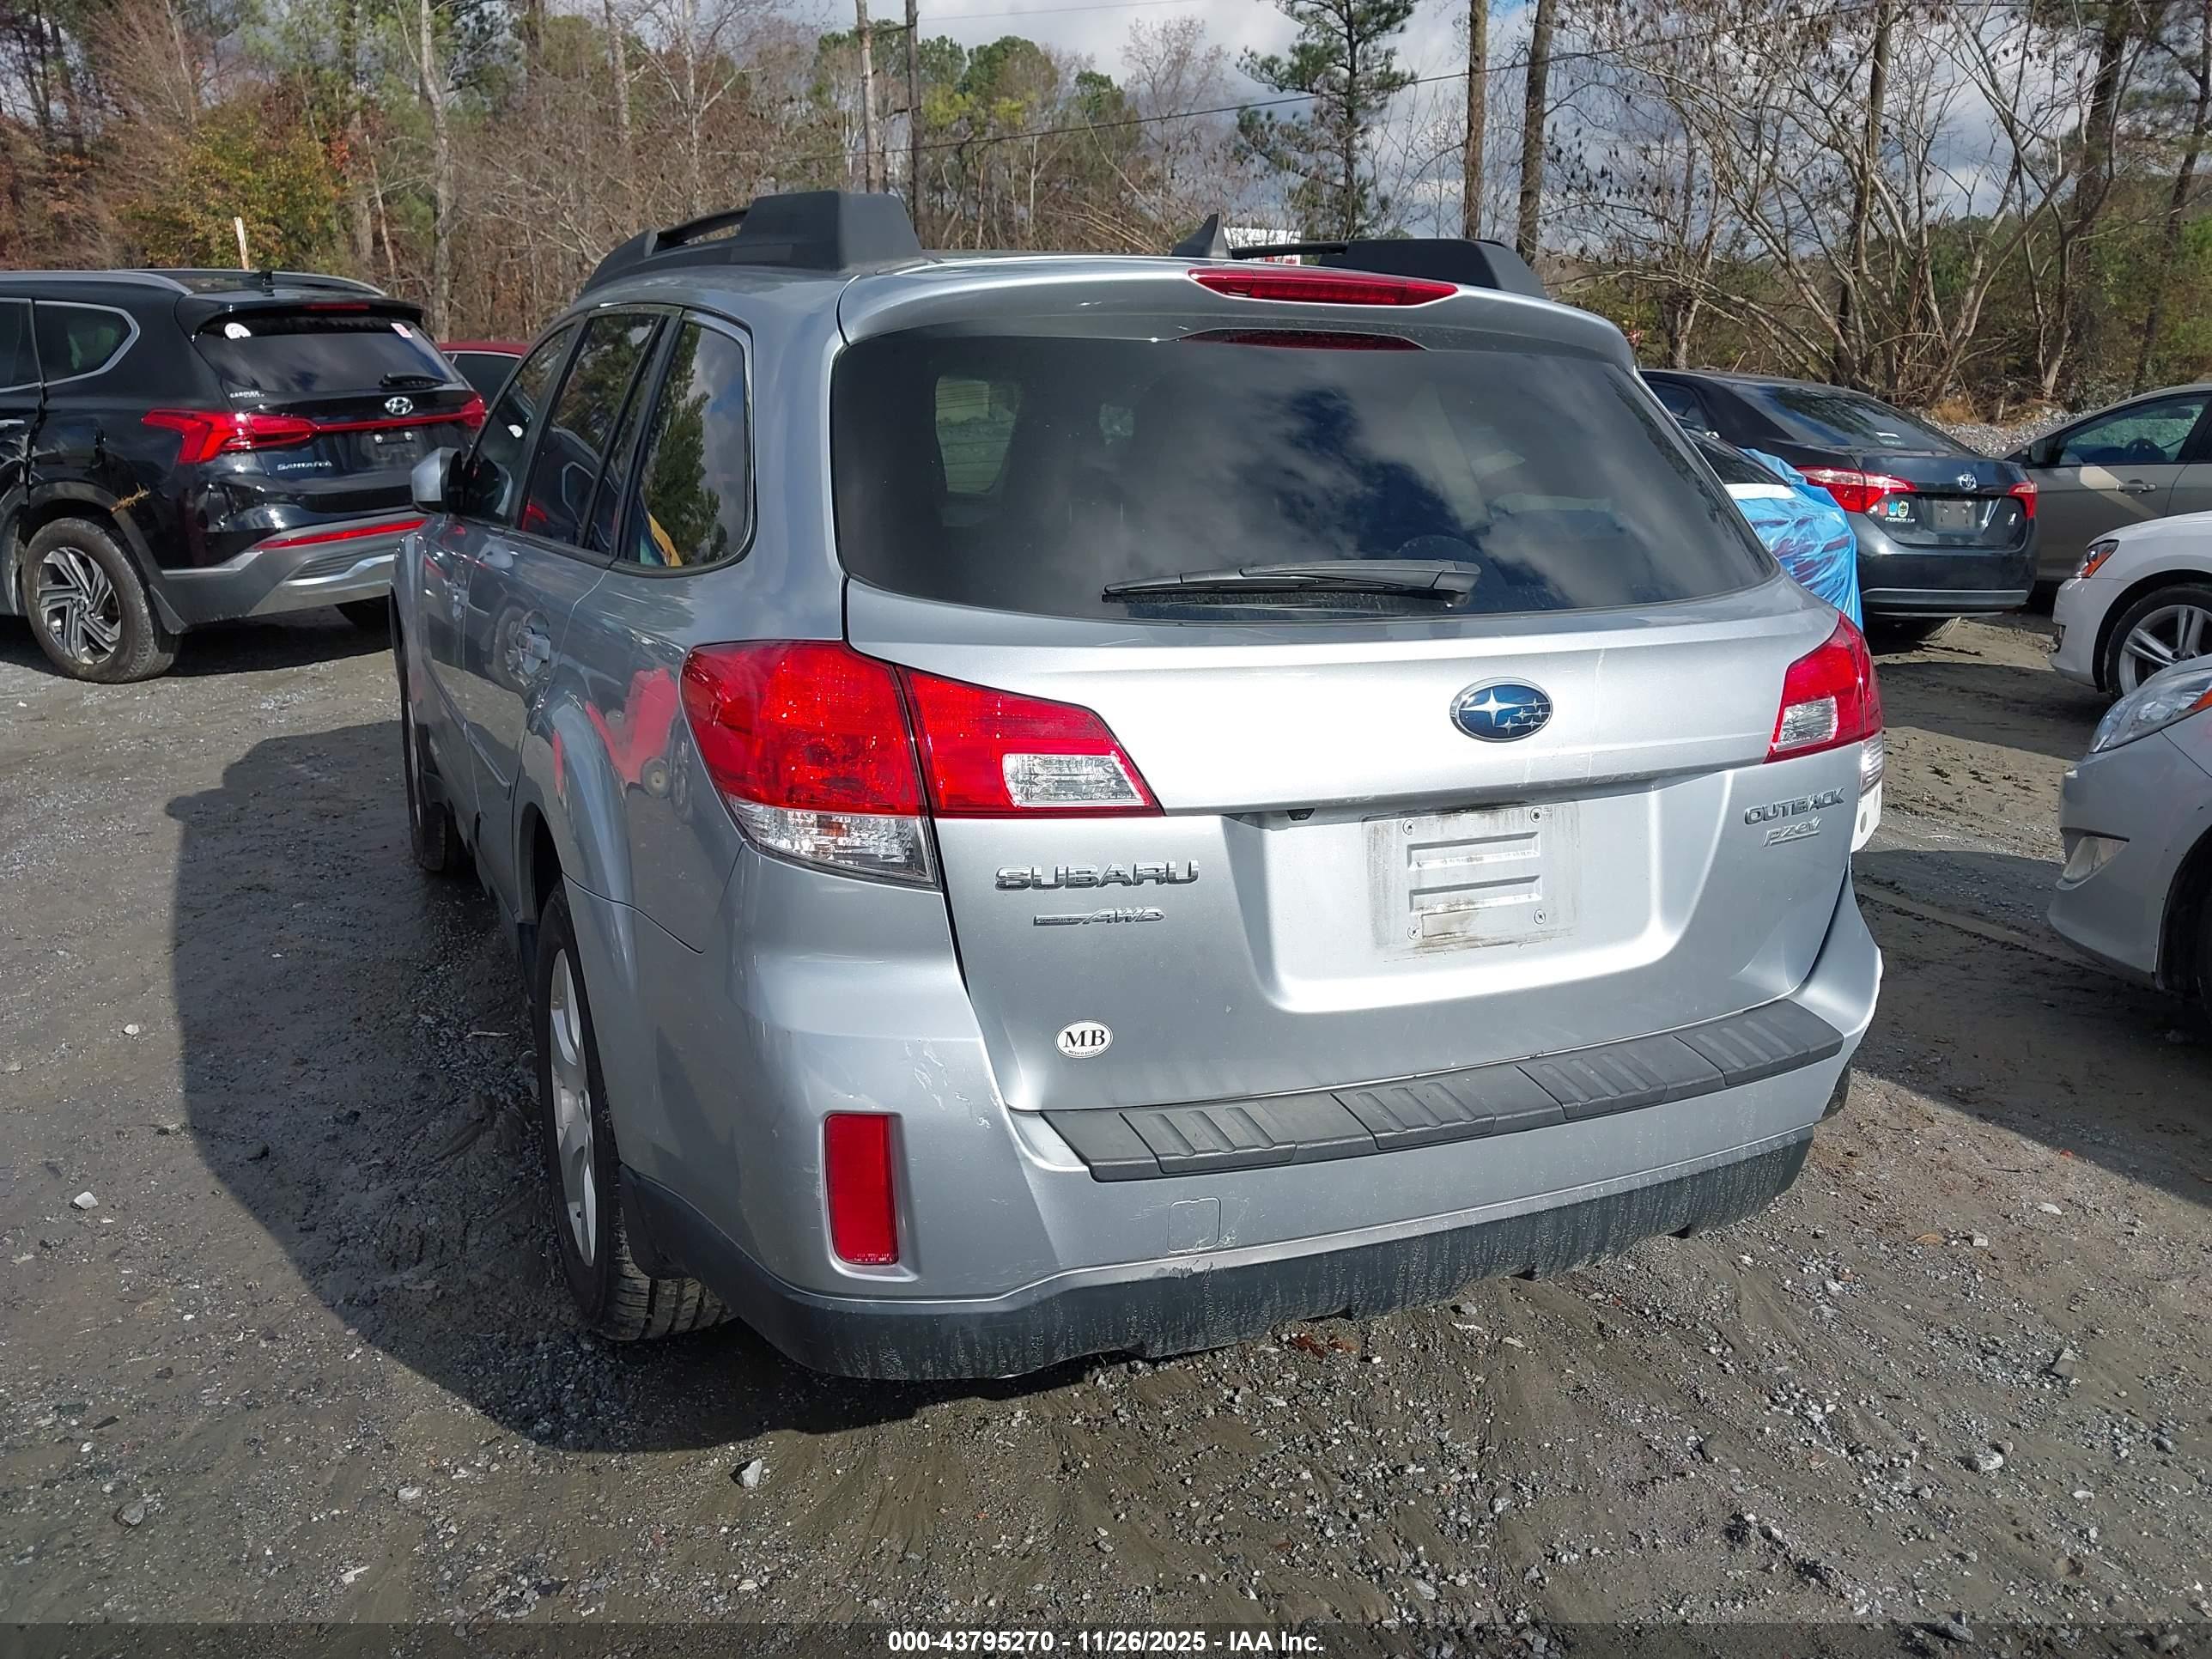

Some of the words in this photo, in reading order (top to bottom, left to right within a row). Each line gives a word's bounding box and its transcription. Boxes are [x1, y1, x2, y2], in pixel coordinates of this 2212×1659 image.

[1744, 787, 1845, 825] OUTBACK
[995, 860, 1200, 890] SUBARU
[1081, 907, 1165, 926] AWD
[1063, 1029, 1106, 1048] MB
